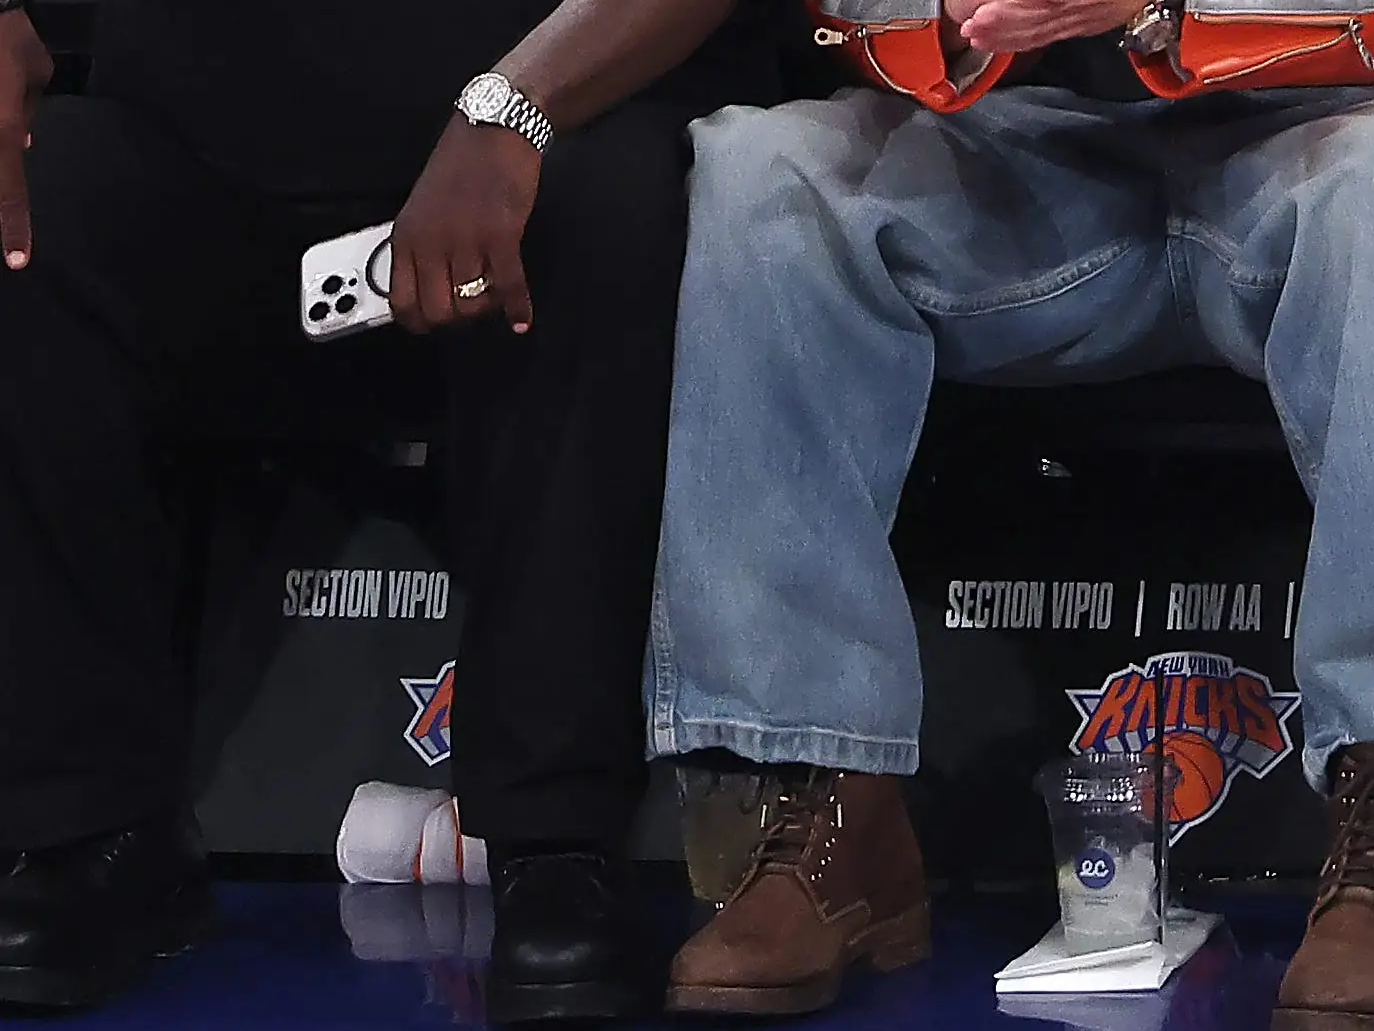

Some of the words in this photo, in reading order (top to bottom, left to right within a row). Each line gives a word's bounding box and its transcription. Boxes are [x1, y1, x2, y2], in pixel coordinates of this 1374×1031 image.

[283, 569, 382, 618] SECTION
[387, 570, 449, 619] VIP10
[945, 580, 1046, 629] SECTION
[1051, 582, 1113, 630] VIP10
[1166, 582, 1226, 632] ROW
[1228, 584, 1261, 632] AA
[1147, 656, 1185, 678] NEW
[1078, 671, 1287, 752] KNICKS
